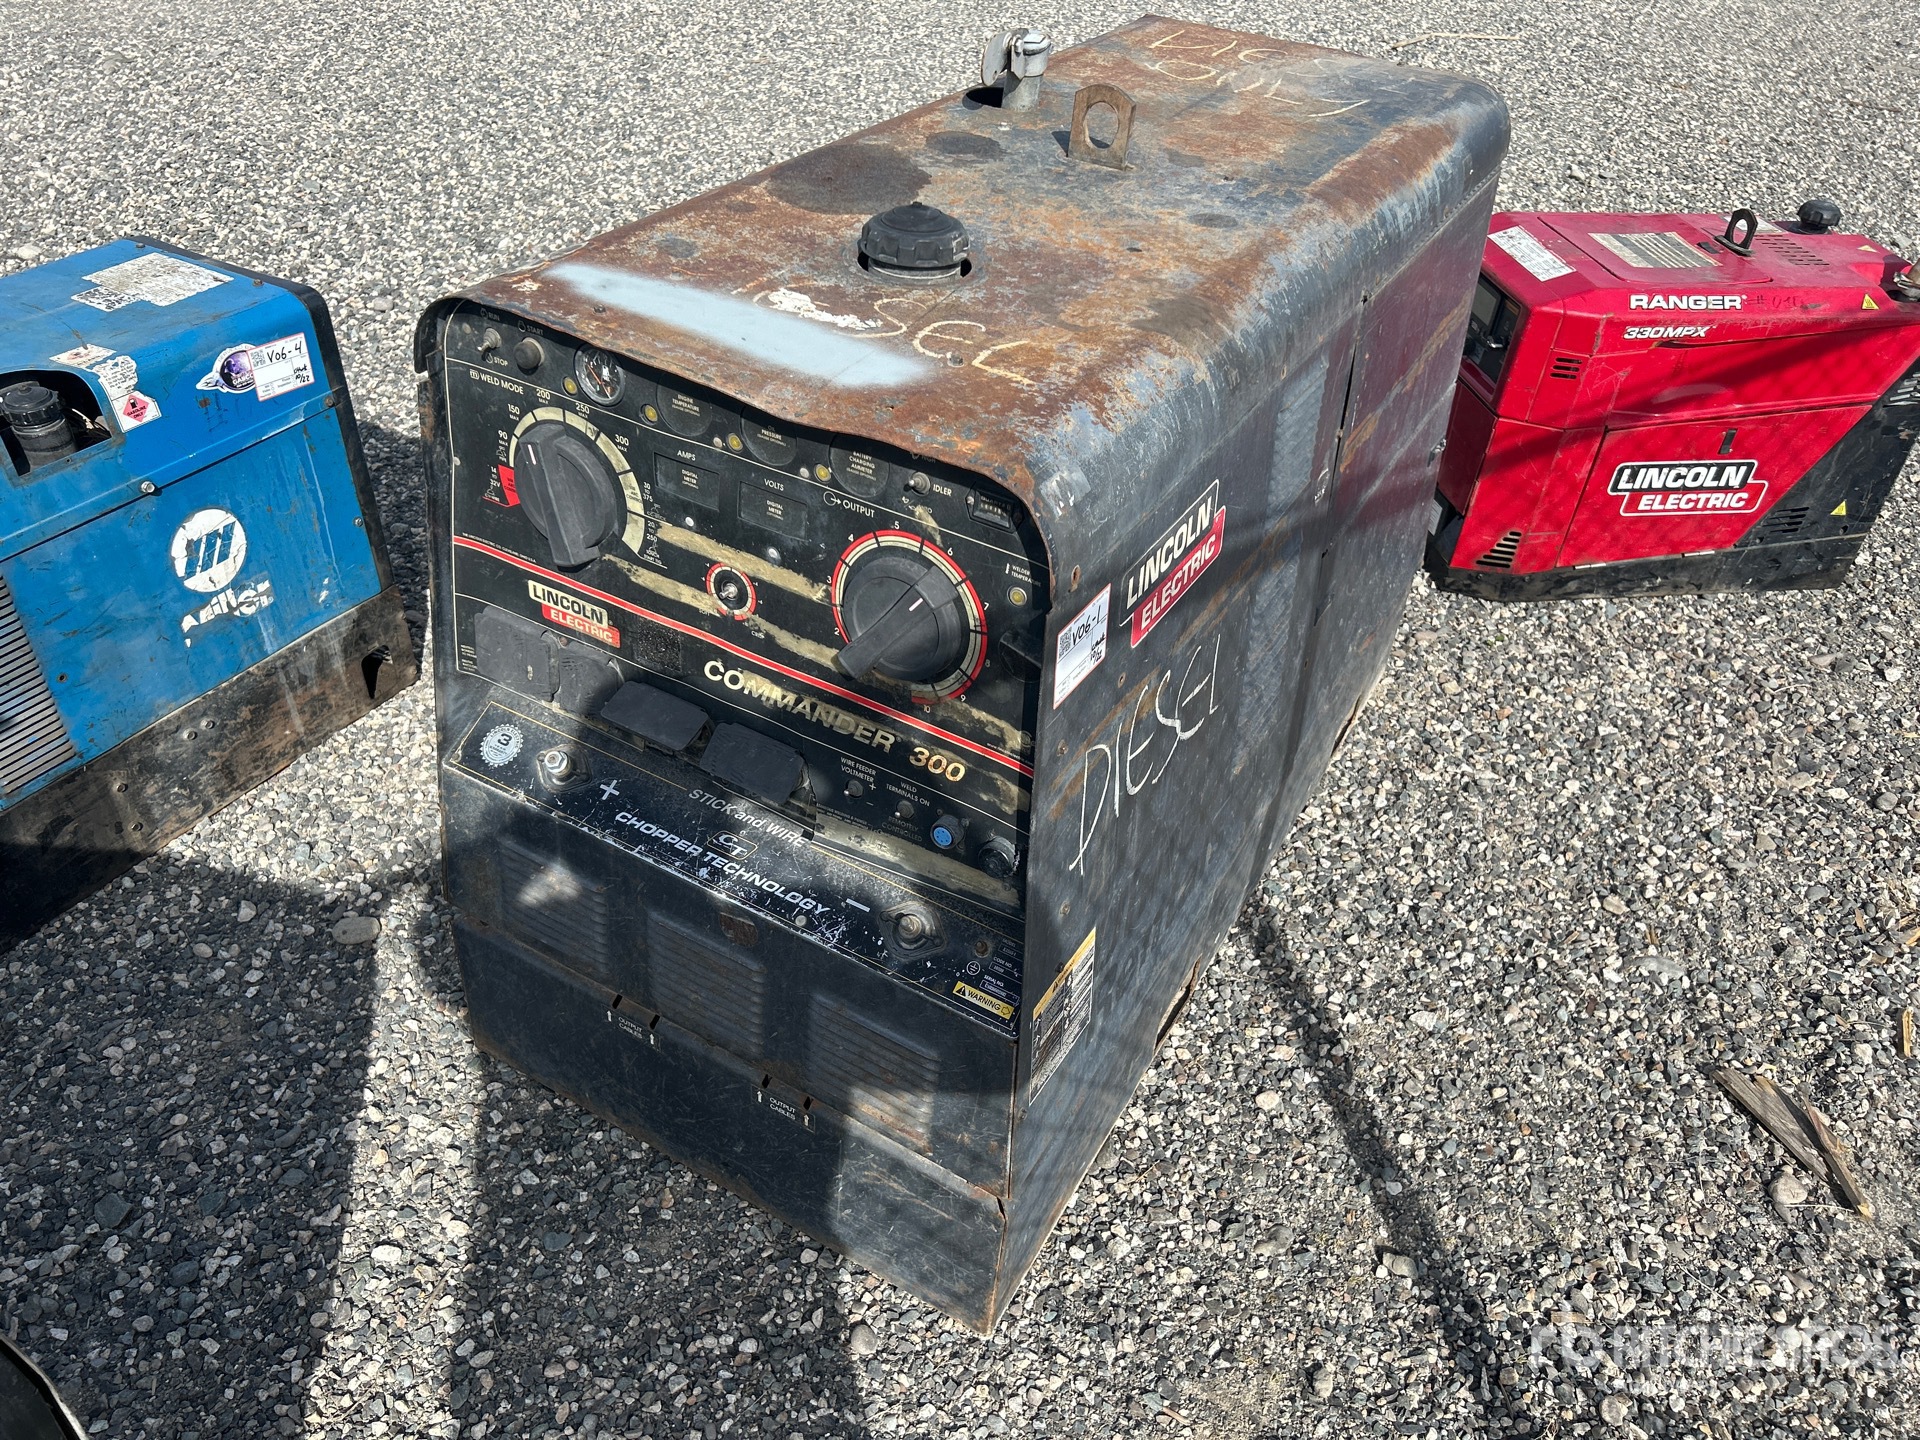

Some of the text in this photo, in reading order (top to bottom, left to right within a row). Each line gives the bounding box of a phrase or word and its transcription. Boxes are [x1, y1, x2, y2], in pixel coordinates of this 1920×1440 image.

[1629, 294, 1743, 310] RANGER
[526, 325, 544, 336] START
[1623, 325, 1712, 340] 330MPX
[494, 357, 509, 367] STOP
[480, 372, 524, 395] WELD MODE
[536, 388, 551, 401] 200
[677, 394, 694, 404] ENGINE
[126, 405, 147, 416] GASOLINE
[507, 403, 520, 415] 150
[575, 402, 590, 415] 250
[672, 398, 700, 413] TEMPERATURE
[133, 411, 144, 419] ONLY
[497, 429, 508, 440] 90
[614, 434, 629, 446] 300
[761, 429, 782, 440] PRESSURE
[677, 450, 696, 461] AMPS
[849, 456, 875, 469] CHARGING
[851, 463, 873, 475] AMMETER
[681, 469, 699, 480] DIGITAL
[683, 475, 697, 484] METER
[1616, 465, 1748, 490] LINCOLN
[764, 478, 784, 492] VOLTS
[932, 483, 952, 497] IDLER
[766, 499, 783, 511] DIGITAL
[1637, 492, 1749, 511] ELECTRIC
[768, 506, 782, 516] METER
[842, 499, 875, 518] OUTPUT
[894, 520, 900, 530] 5
[646, 533, 658, 542] 250
[847, 533, 854, 542] 4
[947, 547, 953, 556] 6
[1126, 495, 1213, 610] LINCOLN
[1011, 564, 1031, 576] WELDER
[826, 575, 832, 584] 3
[1140, 533, 1217, 630] ELECTRIC
[532, 584, 604, 625] LINCOLN
[983, 601, 990, 611] 7
[550, 608, 613, 643] ELECTRIC
[834, 627, 840, 636] 2
[960, 694, 966, 702] 9
[923, 705, 931, 714] 10
[702, 659, 966, 782] COMMANDER 300
[497, 733, 513, 747] 3
[1068, 633, 1221, 876] DIESEL
[840, 756, 877, 776] WIRE FEEDER
[840, 765, 875, 782] VOLTMETER
[900, 781, 917, 793] WELD
[886, 783, 930, 807] TERMINALS ON
[688, 789, 807, 848] STICK and WIRE
[888, 815, 919, 832] REMOTELY
[881, 822, 922, 841] CONTROLLED
[614, 811, 832, 917] CHOPPER TECHNOLOGY
[967, 989, 1001, 1011] WARNING
[618, 1016, 642, 1033] OUTPUT
[618, 1022, 643, 1039] CABLES
[769, 1097, 796, 1114] OUTPUT
[769, 1103, 796, 1120] CABLES
